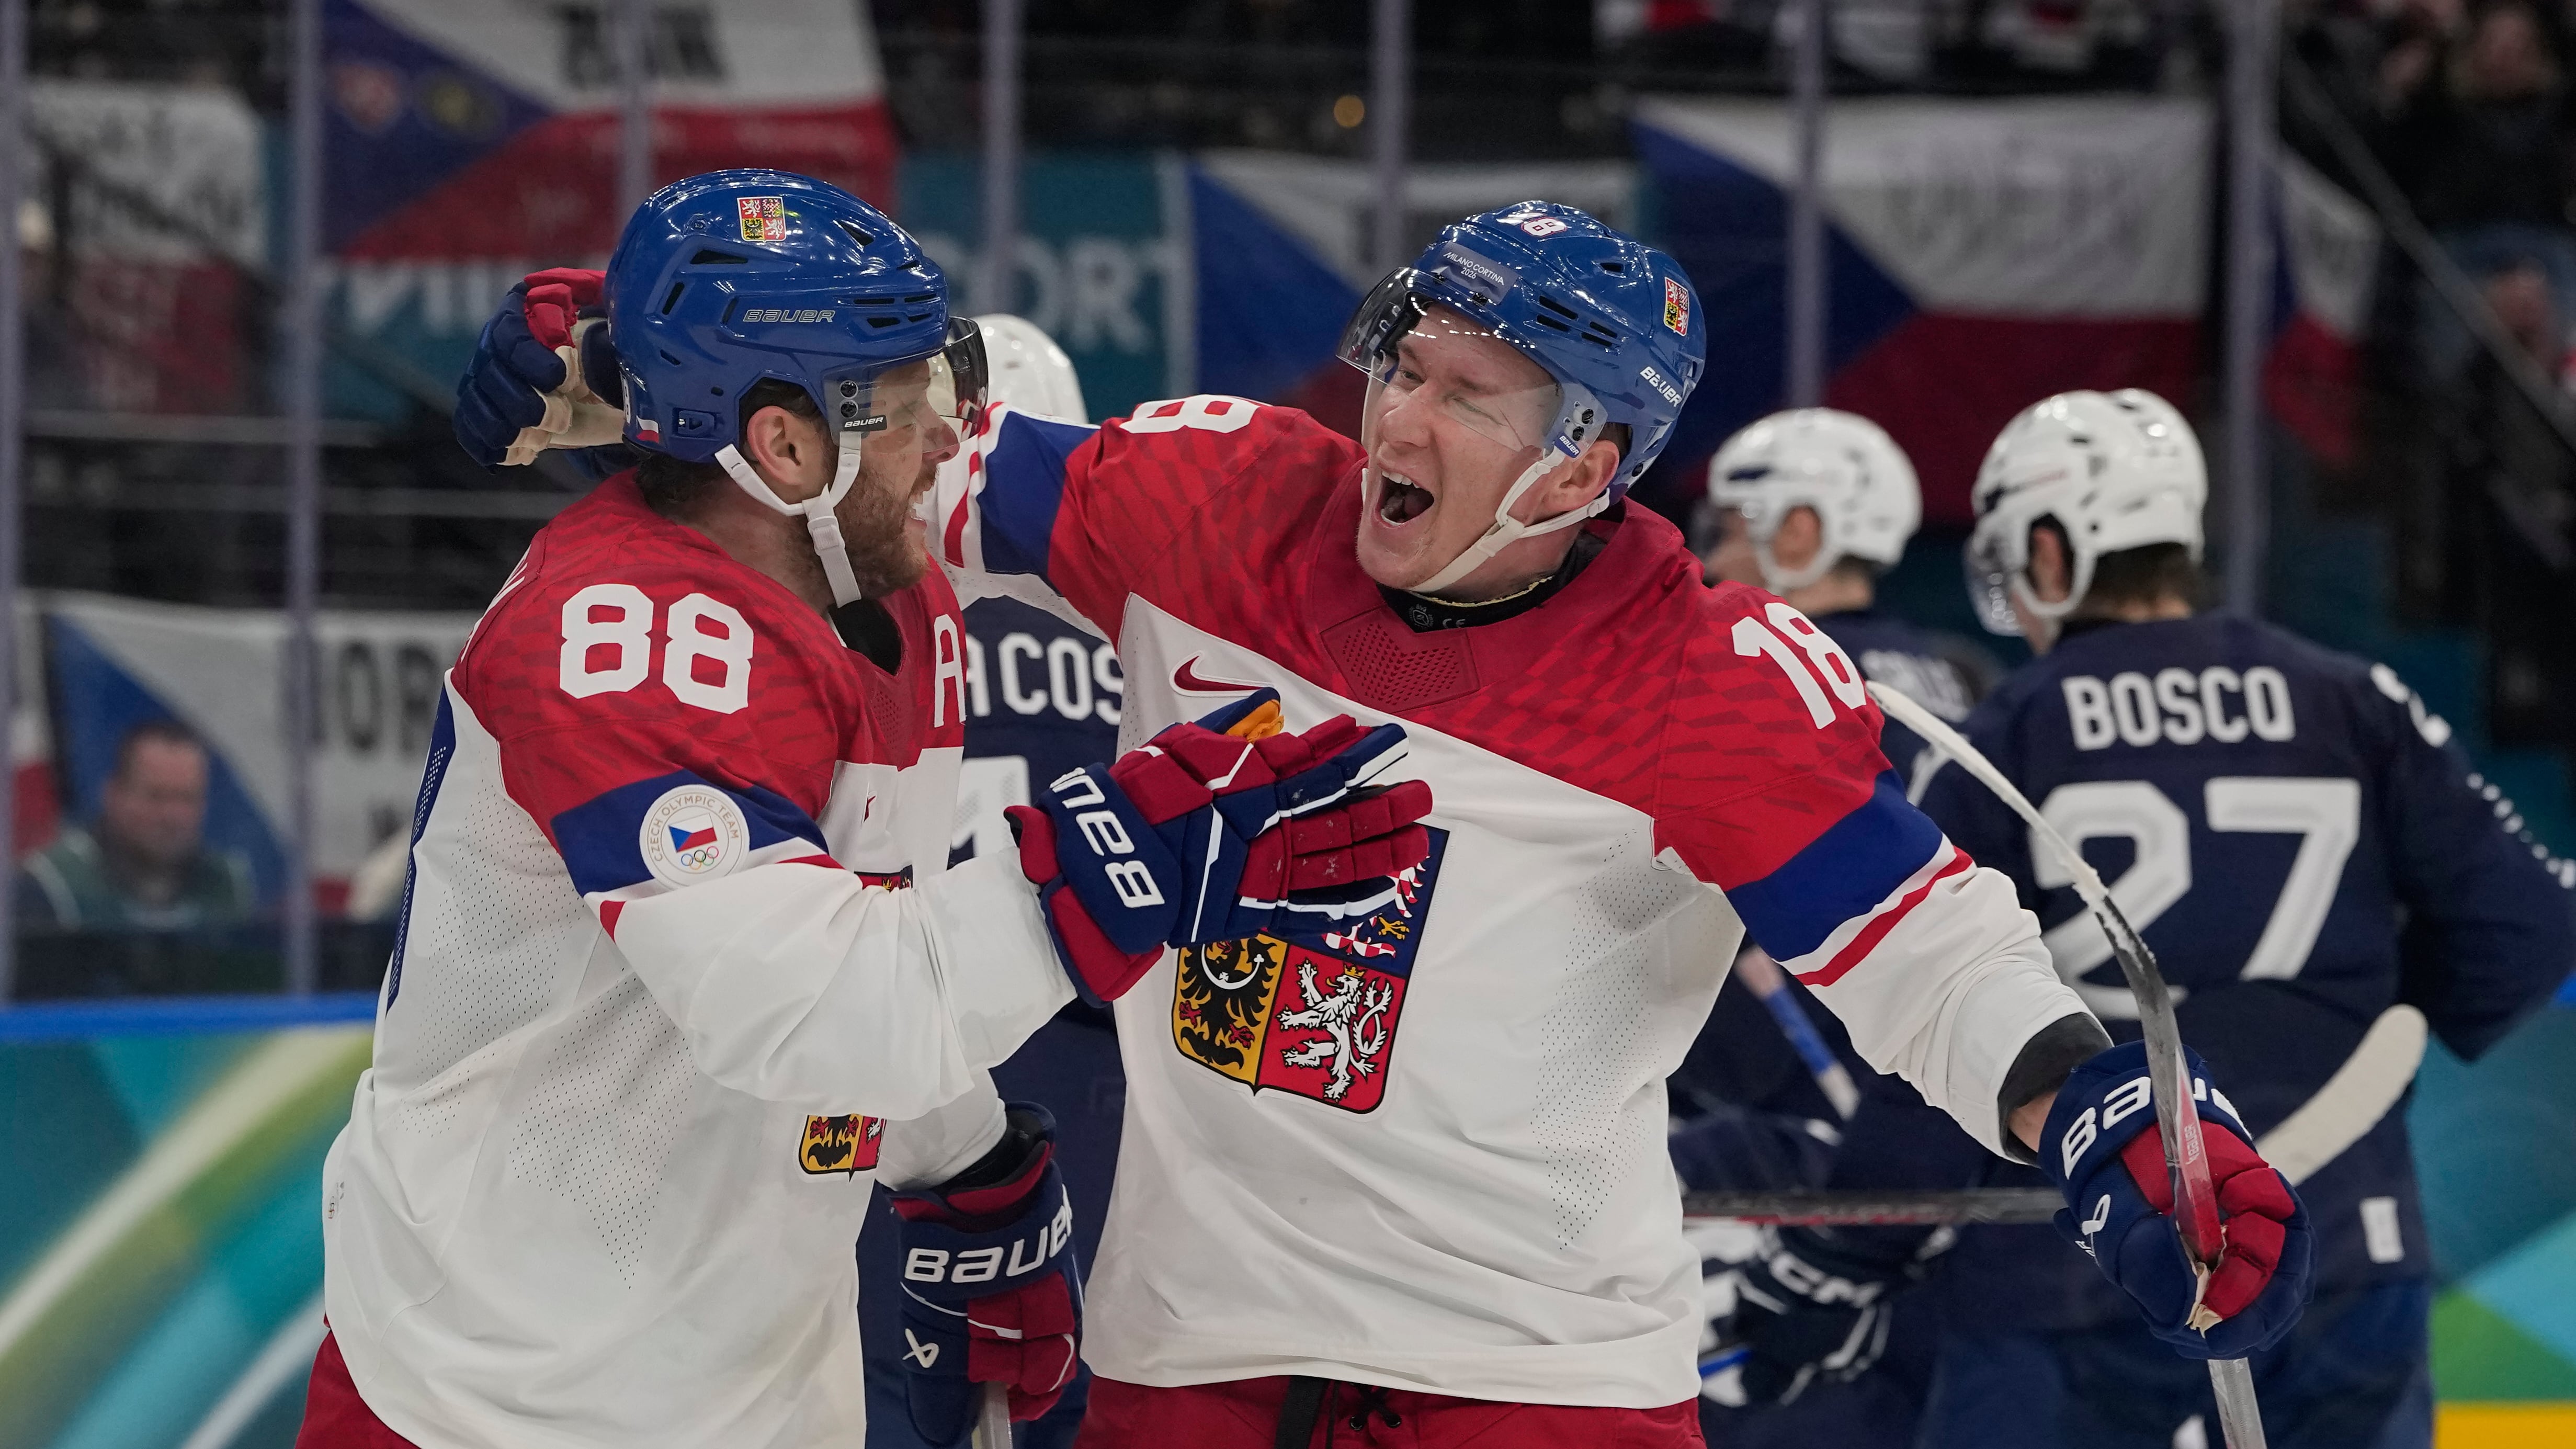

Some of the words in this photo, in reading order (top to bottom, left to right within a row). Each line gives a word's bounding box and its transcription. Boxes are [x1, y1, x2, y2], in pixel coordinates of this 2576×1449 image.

[1443, 252, 1473, 268] MILANO
[1472, 264, 1504, 286] CORTINA
[1460, 267, 1477, 279] 2026
[743, 309, 835, 323] BAUER
[1640, 366, 1683, 407] BAUER
[844, 416, 884, 428] BAUER
[1559, 435, 1579, 456] BAUER
[560, 583, 754, 715] 88
[1731, 602, 1866, 730] 18
[934, 614, 967, 728] A
[650, 819, 663, 862] CZECH
[662, 795, 716, 816] OLYMPIC
[718, 803, 739, 839] TEAM
[2027, 775, 2363, 1020] 27
